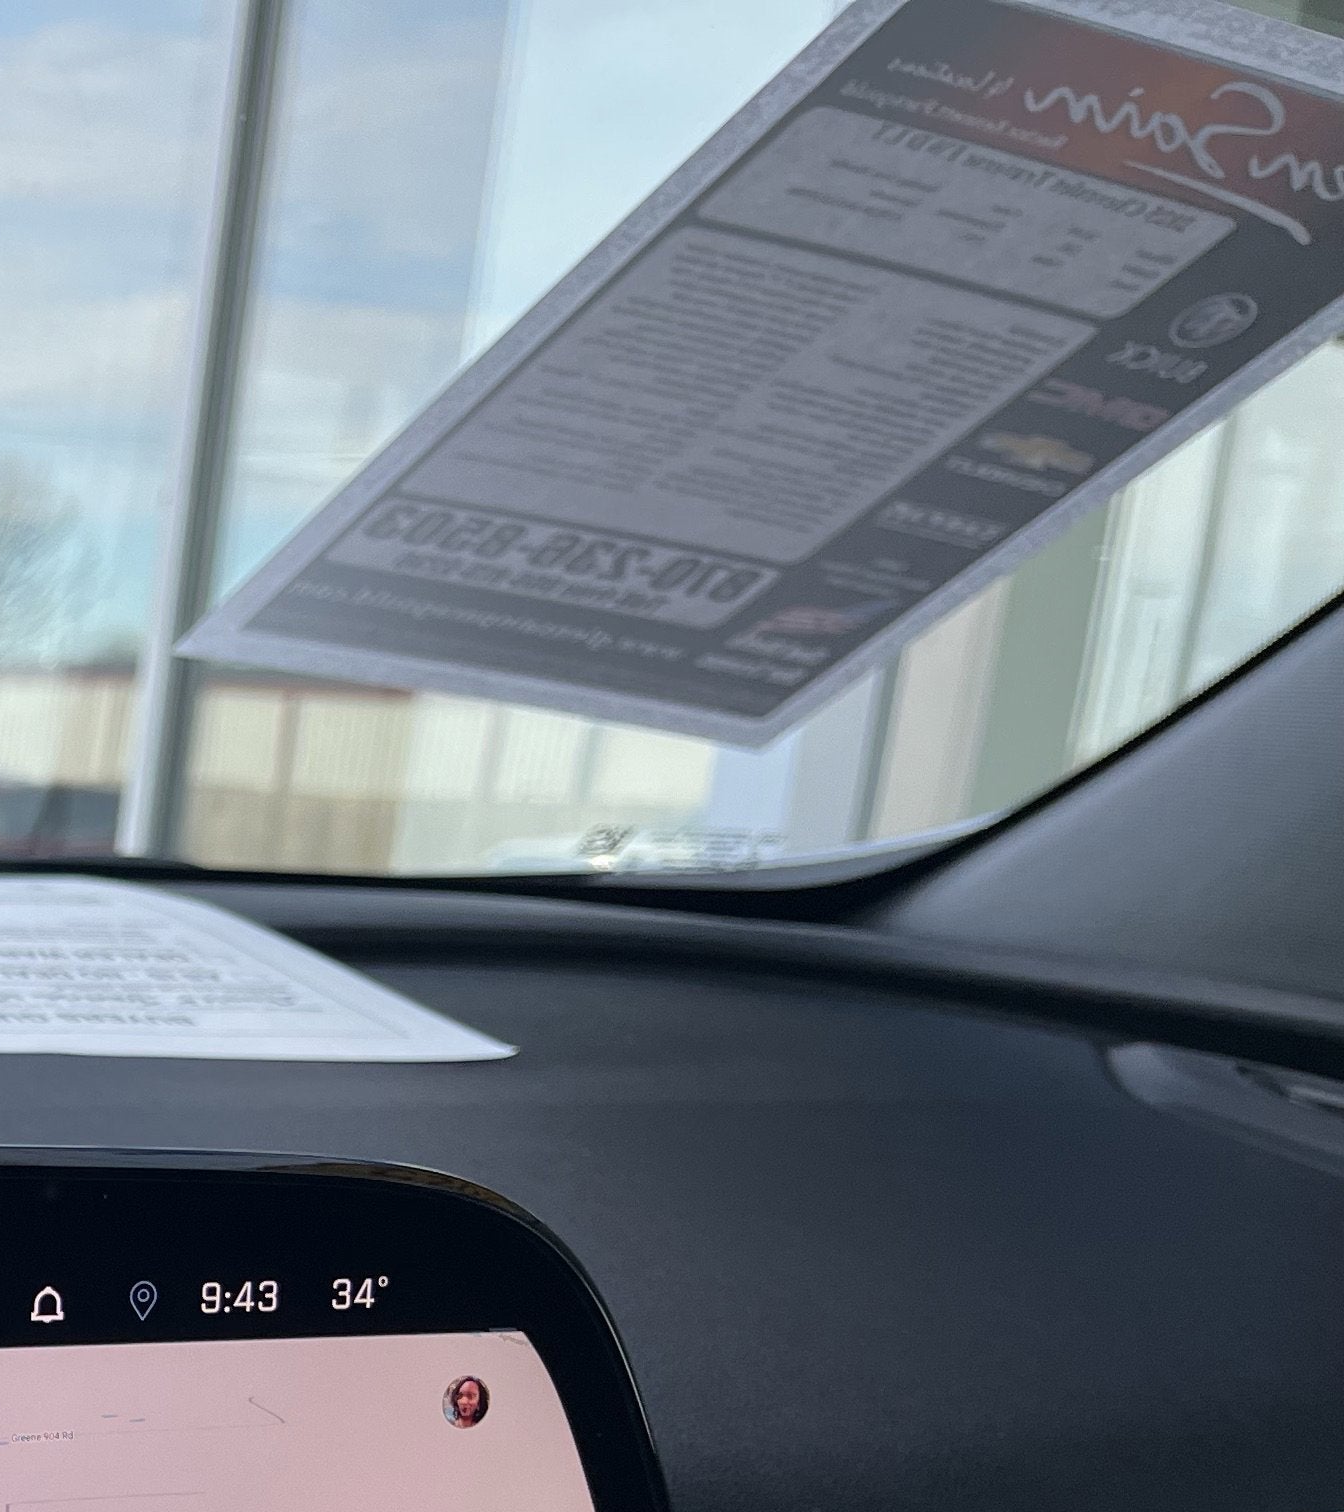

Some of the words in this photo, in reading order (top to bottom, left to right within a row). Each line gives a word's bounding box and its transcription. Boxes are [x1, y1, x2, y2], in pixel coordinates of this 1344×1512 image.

[200, 1280, 279, 1314] 9:43
[331, 1275, 389, 1310] 34°
[12, 1433, 42, 1442] Greene
